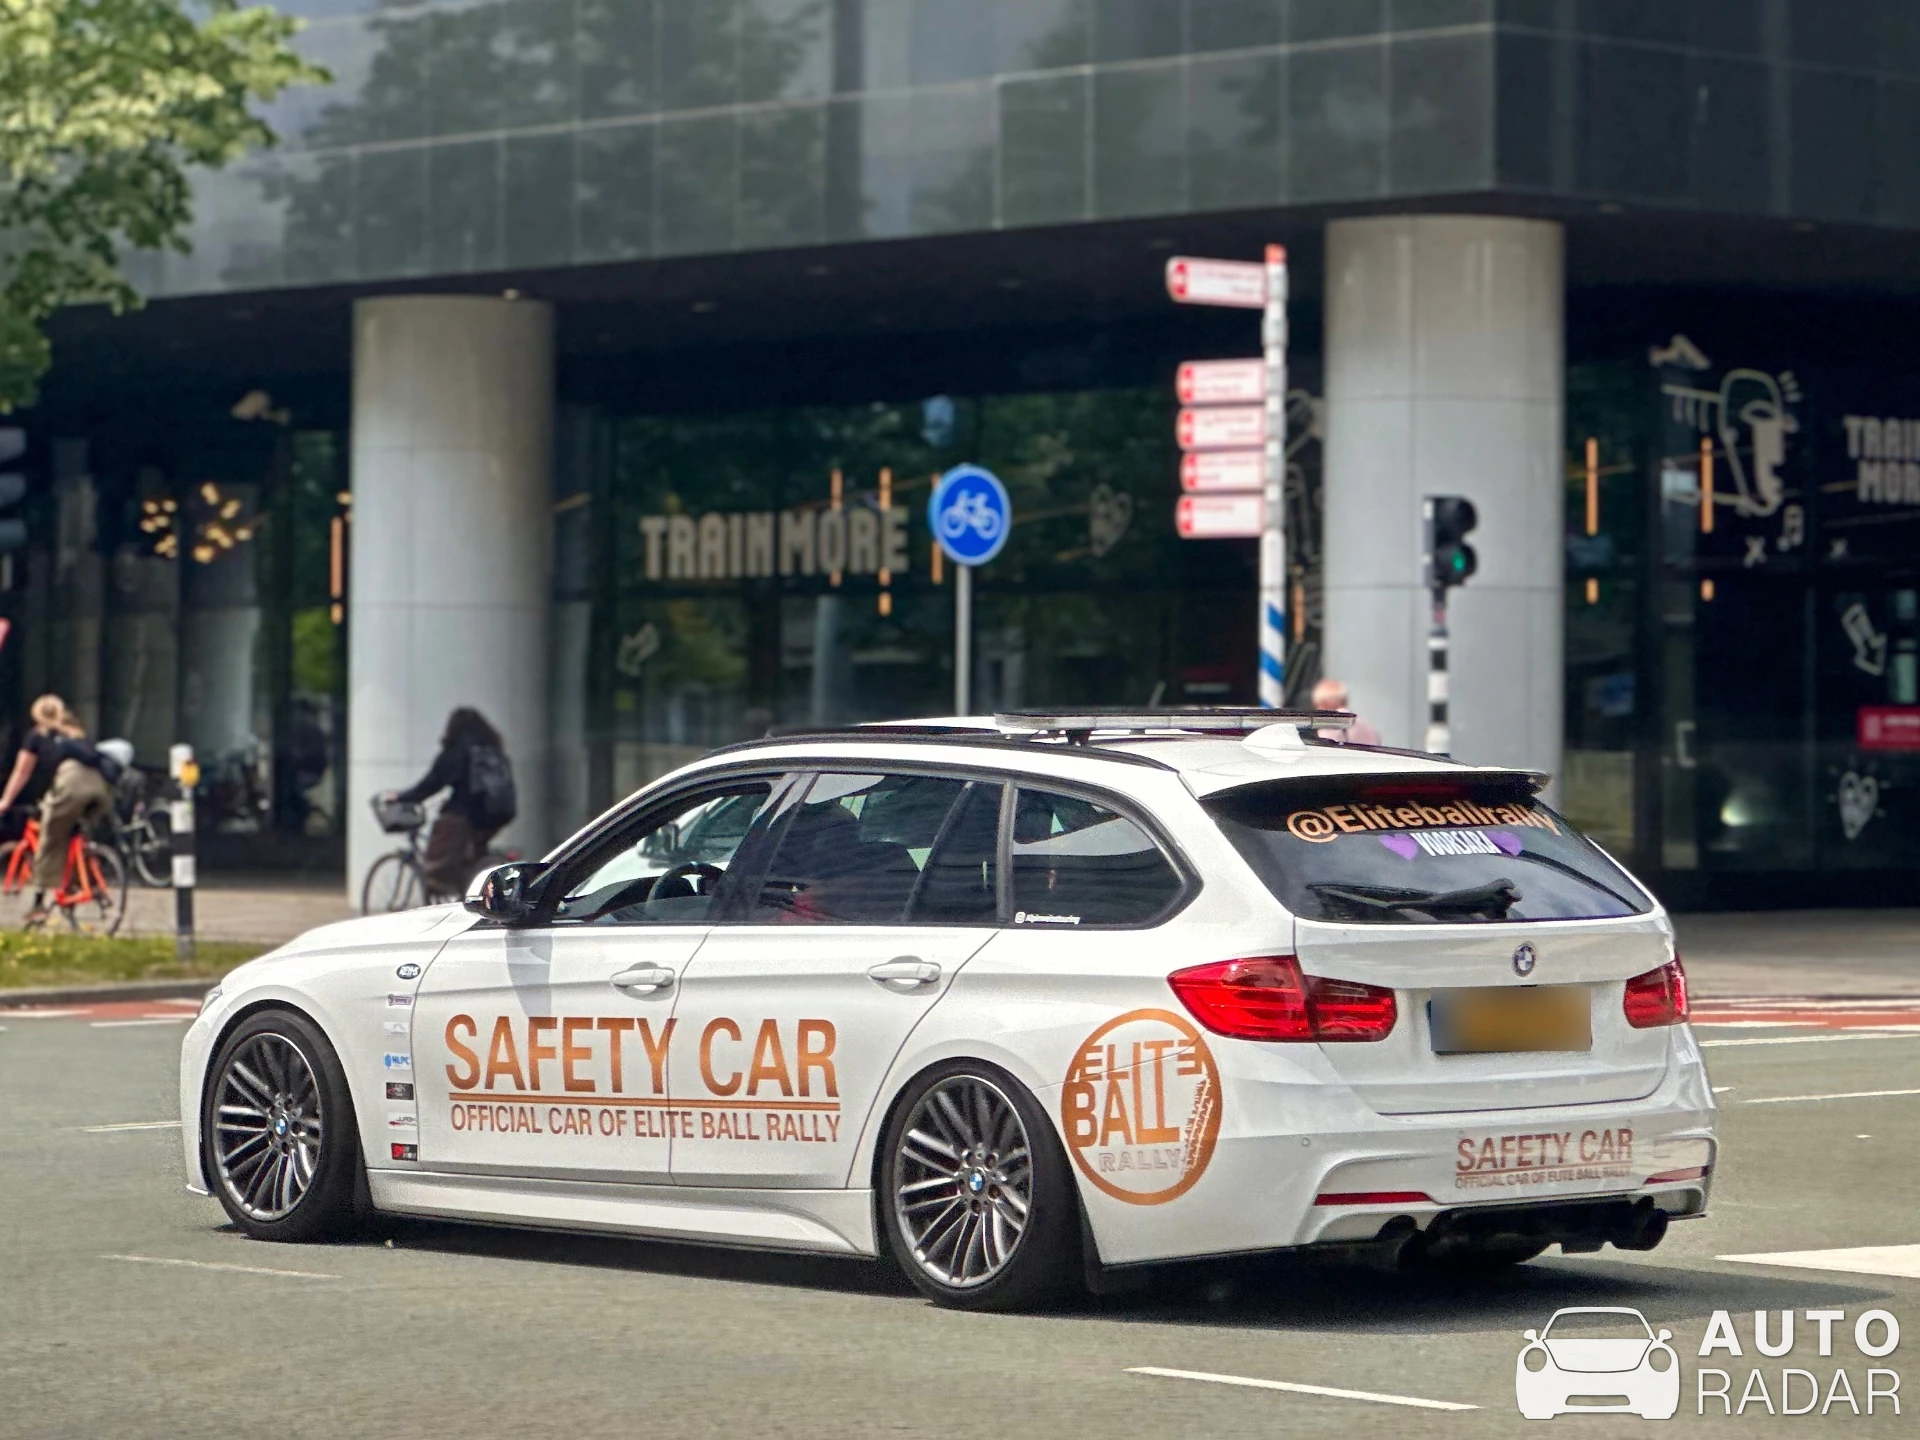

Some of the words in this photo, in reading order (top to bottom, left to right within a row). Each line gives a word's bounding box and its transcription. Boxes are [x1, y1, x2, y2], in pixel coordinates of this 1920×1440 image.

[1287, 800, 1562, 844] @Eliteballrally
[445, 1014, 678, 1094] SAFETY
[700, 1017, 839, 1098] CAR
[451, 1103, 542, 1134] OFFICIAL
[549, 1109, 593, 1136] CAR
[599, 1109, 627, 1137] OF
[635, 1110, 694, 1139] ELITE
[702, 1112, 760, 1141] BALL
[767, 1114, 841, 1143] RALLY
[1099, 1148, 1181, 1172] RALLY
[1456, 1132, 1571, 1171] SAFETY
[1580, 1128, 1634, 1163] CAR
